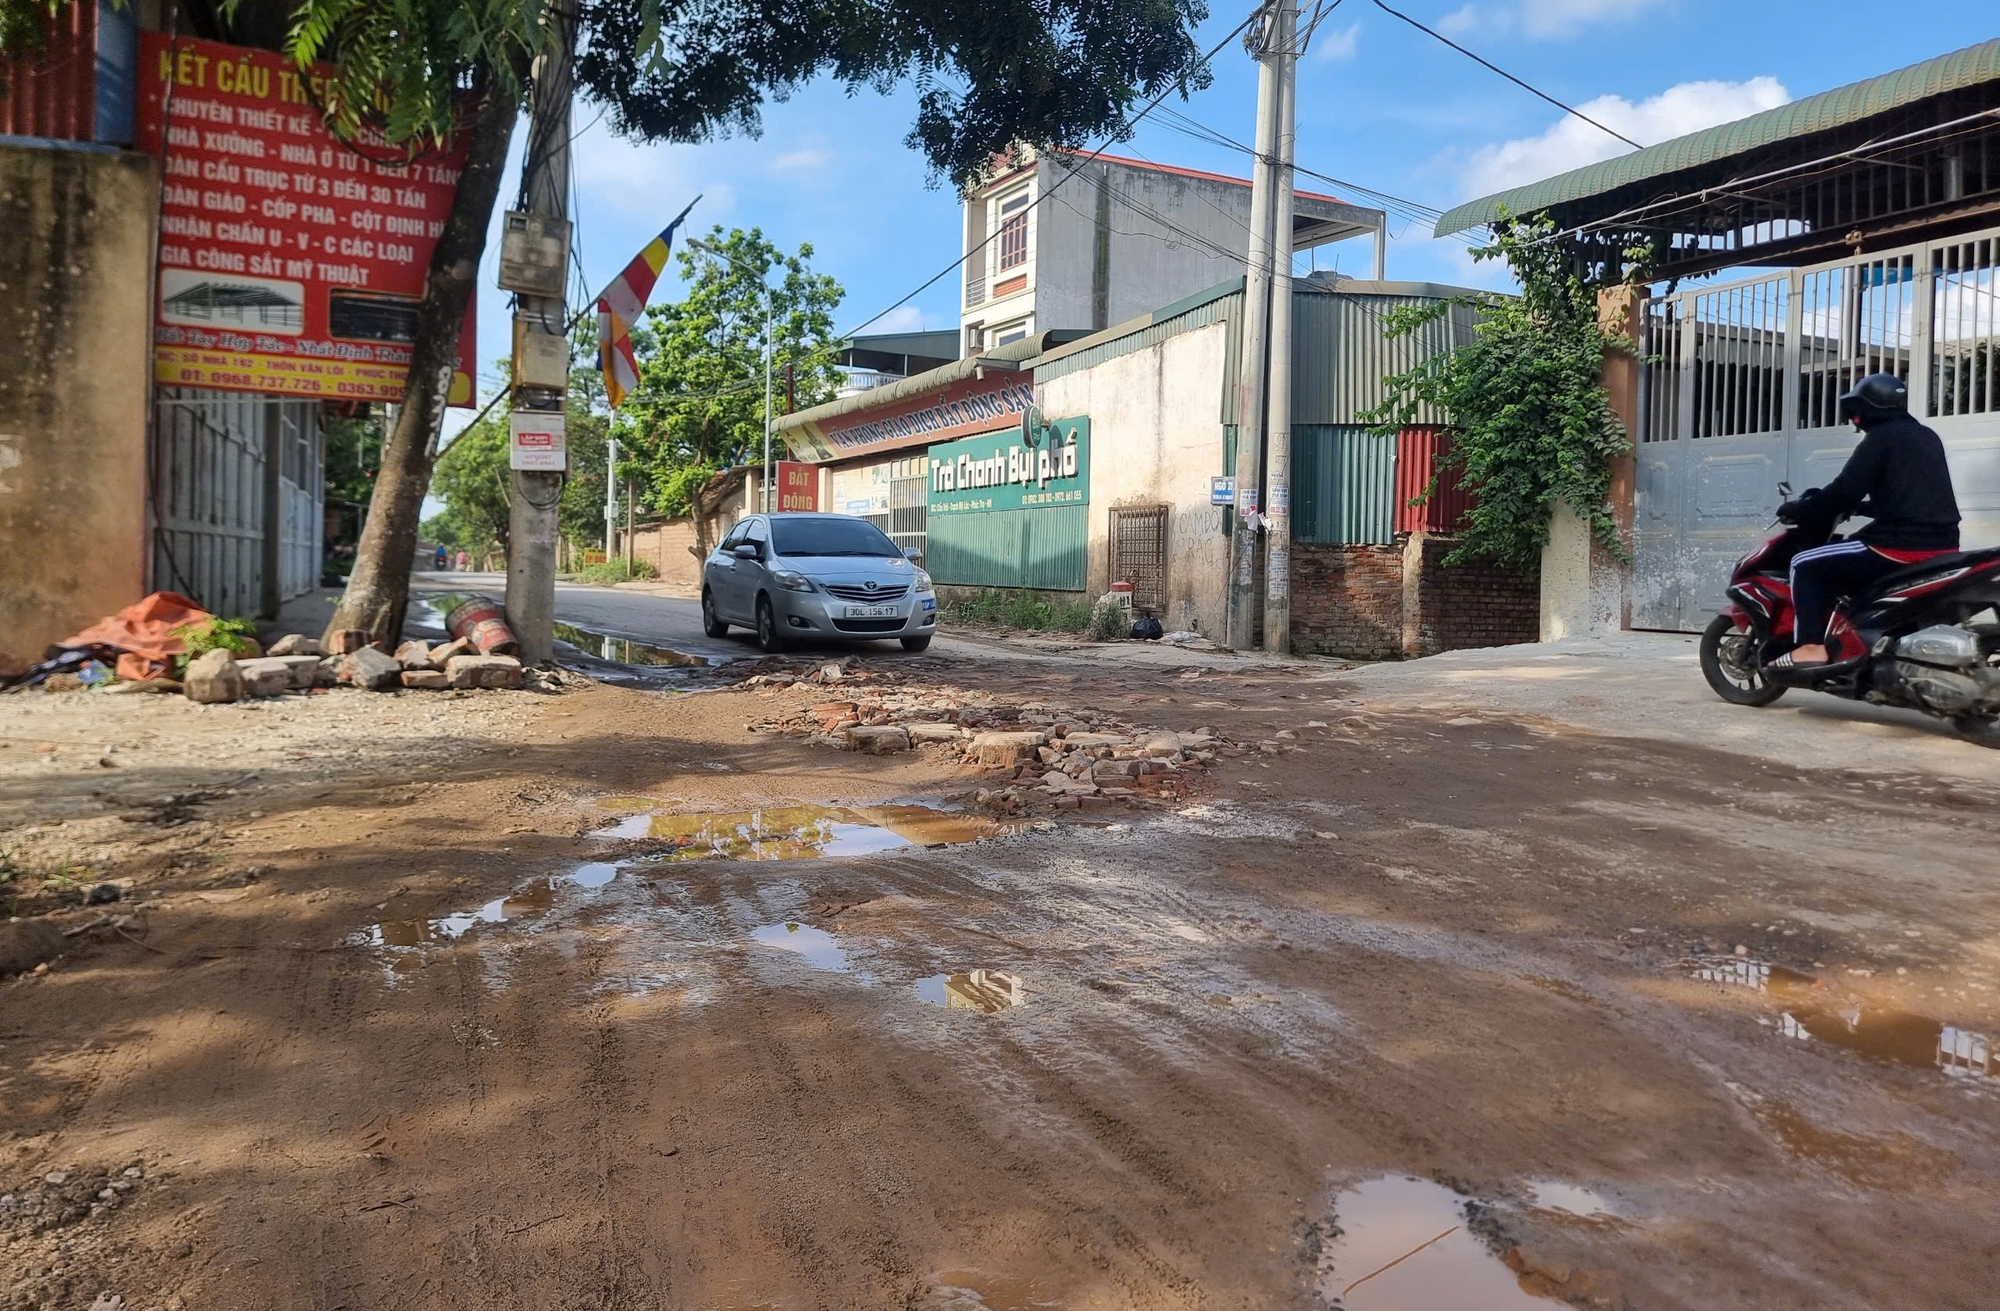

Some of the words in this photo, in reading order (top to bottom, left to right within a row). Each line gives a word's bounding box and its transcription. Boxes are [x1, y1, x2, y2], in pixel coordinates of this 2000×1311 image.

[237, 107, 286, 132] THIẾT
[288, 114, 312, 136] KẾ
[281, 143, 317, 166] NHÀ
[413, 164, 422, 181] 7
[245, 167, 289, 192] TRỤC
[319, 178, 329, 193] 3
[334, 176, 367, 201] ĐẾN
[371, 186, 391, 205] 30
[204, 189, 246, 214] GIÁO
[262, 194, 297, 220] CỐP
[301, 204, 336, 225] PHA
[351, 208, 383, 233] CỘT
[386, 215, 425, 238] ĐỊNH
[161, 245, 191, 266] GIA
[196, 249, 245, 272] CÔNG
[249, 250, 282, 276] SẮT
[287, 258, 312, 280] MỸ
[318, 265, 369, 288] THUẬT
[269, 229, 282, 247] U
[298, 232, 309, 250] V
[324, 236, 336, 253] C
[340, 235, 374, 257] CÁC
[378, 242, 414, 266] LOẠI
[187, 330, 219, 349] Tay
[375, 347, 414, 365] Thàn
[882, 413, 912, 441] GIAO
[905, 405, 942, 438] DỊCH
[932, 394, 966, 429] BẤT
[959, 391, 1005, 427] ĐỘNG
[789, 467, 810, 487] BẤT
[931, 456, 956, 493] Trà
[957, 449, 1009, 490] Chanh
[1008, 445, 1036, 489] Bụi
[1037, 426, 1079, 490] phố
